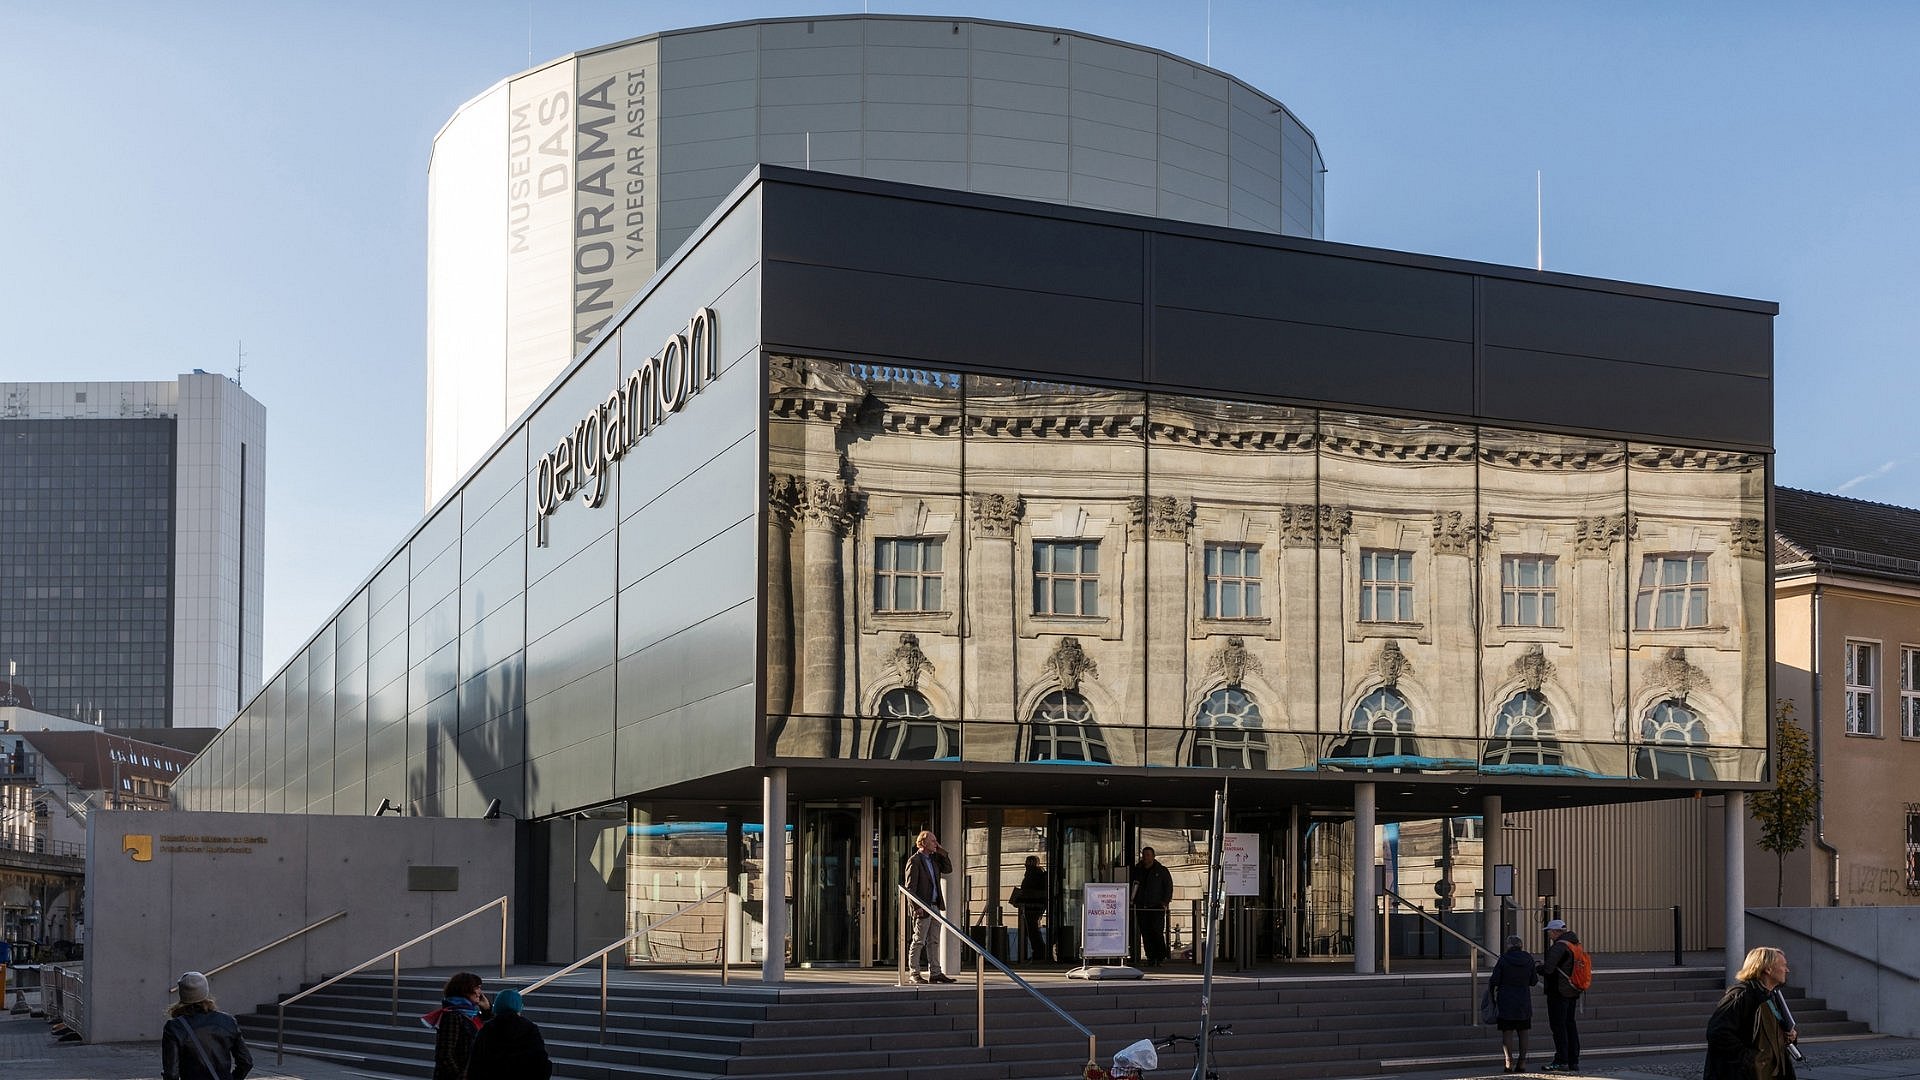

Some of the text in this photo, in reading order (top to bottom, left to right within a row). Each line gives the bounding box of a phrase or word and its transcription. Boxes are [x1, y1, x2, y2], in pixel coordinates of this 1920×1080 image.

[510, 102, 532, 254] MUSEUM
[537, 90, 570, 200] DAS
[575, 75, 617, 344] ANORAMA
[625, 68, 646, 260] YADEGAR ASISI
[536, 306, 719, 549] pergamon
